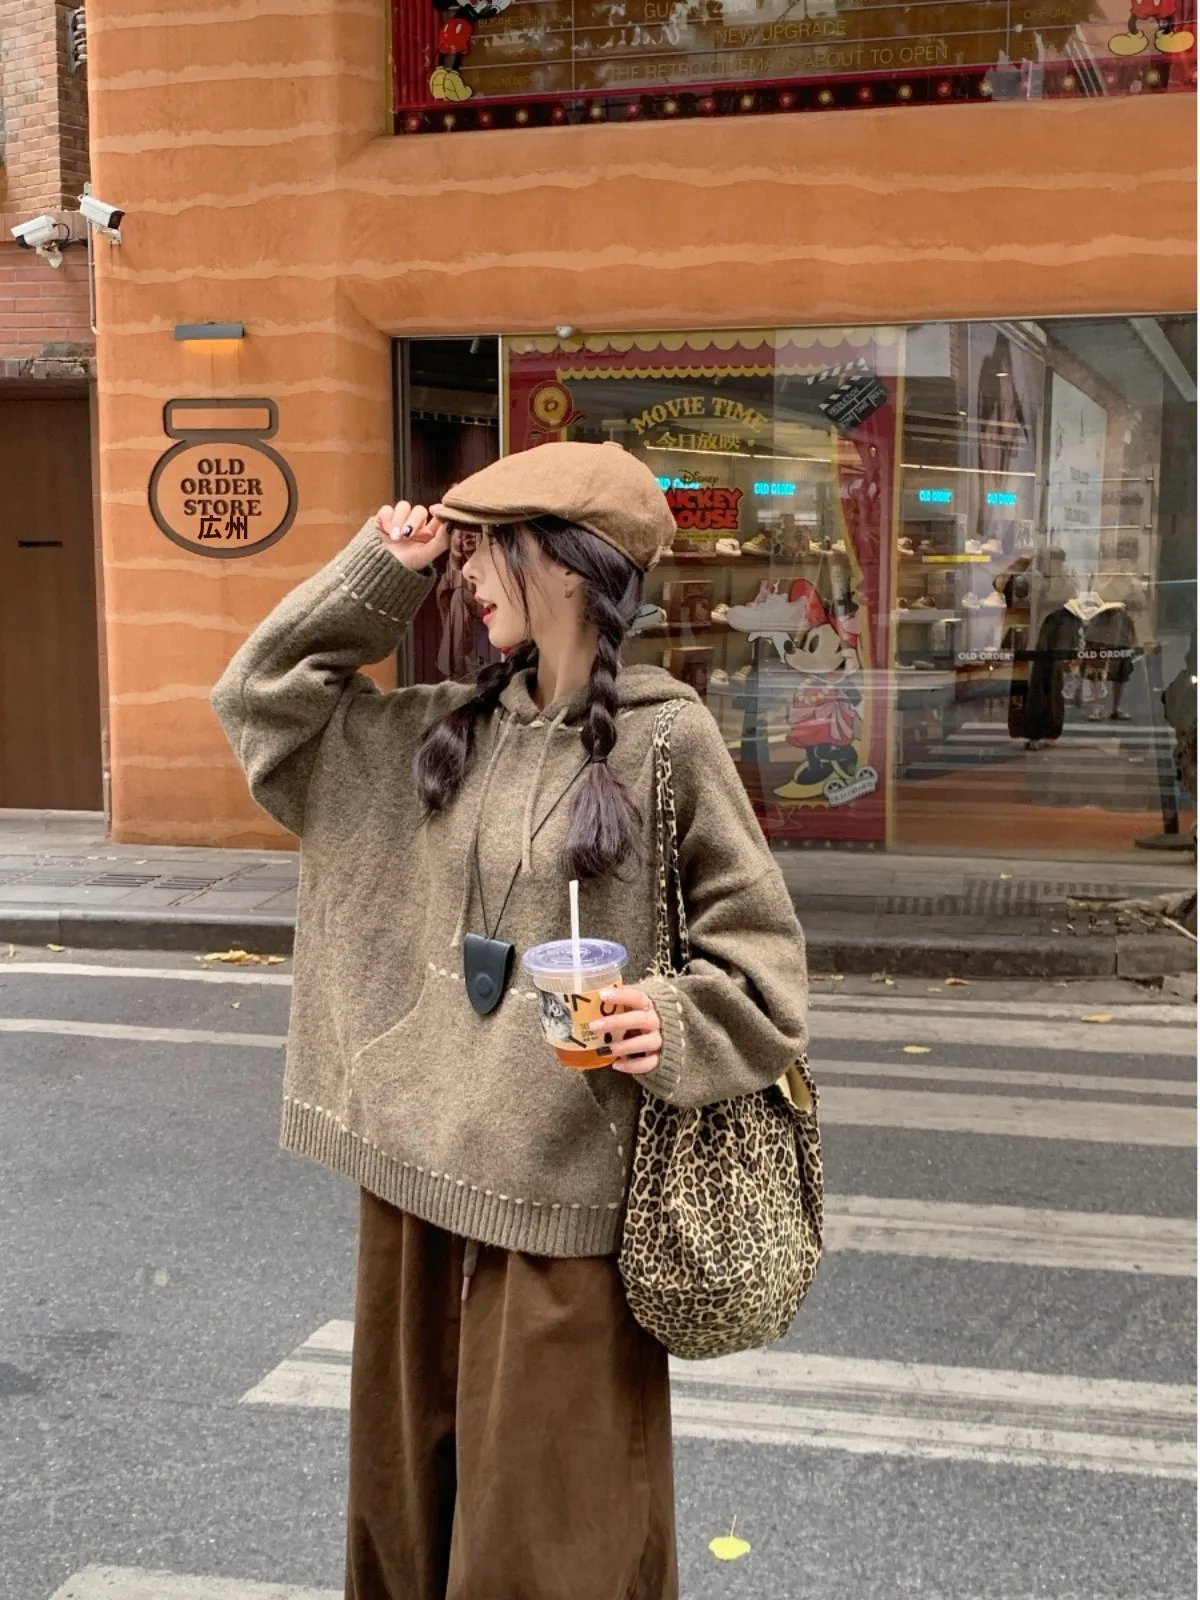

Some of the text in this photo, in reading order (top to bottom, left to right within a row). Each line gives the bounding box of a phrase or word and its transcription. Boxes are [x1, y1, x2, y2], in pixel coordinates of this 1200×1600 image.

[715, 19, 848, 45] NEW UPGRADE
[646, 60, 702, 80] RETRO
[806, 48, 866, 69] ABOUT
[870, 48, 894, 65] TO
[899, 43, 948, 63] OPEN
[631, 396, 769, 435] MOVIE TIME
[656, 431, 741, 451] 今日放映
[197, 458, 246, 476] OLD
[180, 478, 264, 496] ORDER
[183, 499, 262, 517] STORE
[197, 515, 248, 540] 広州
[675, 508, 738, 530] OUSE
[957, 652, 977, 661] OLD
[1077, 651, 1097, 660] OLD
